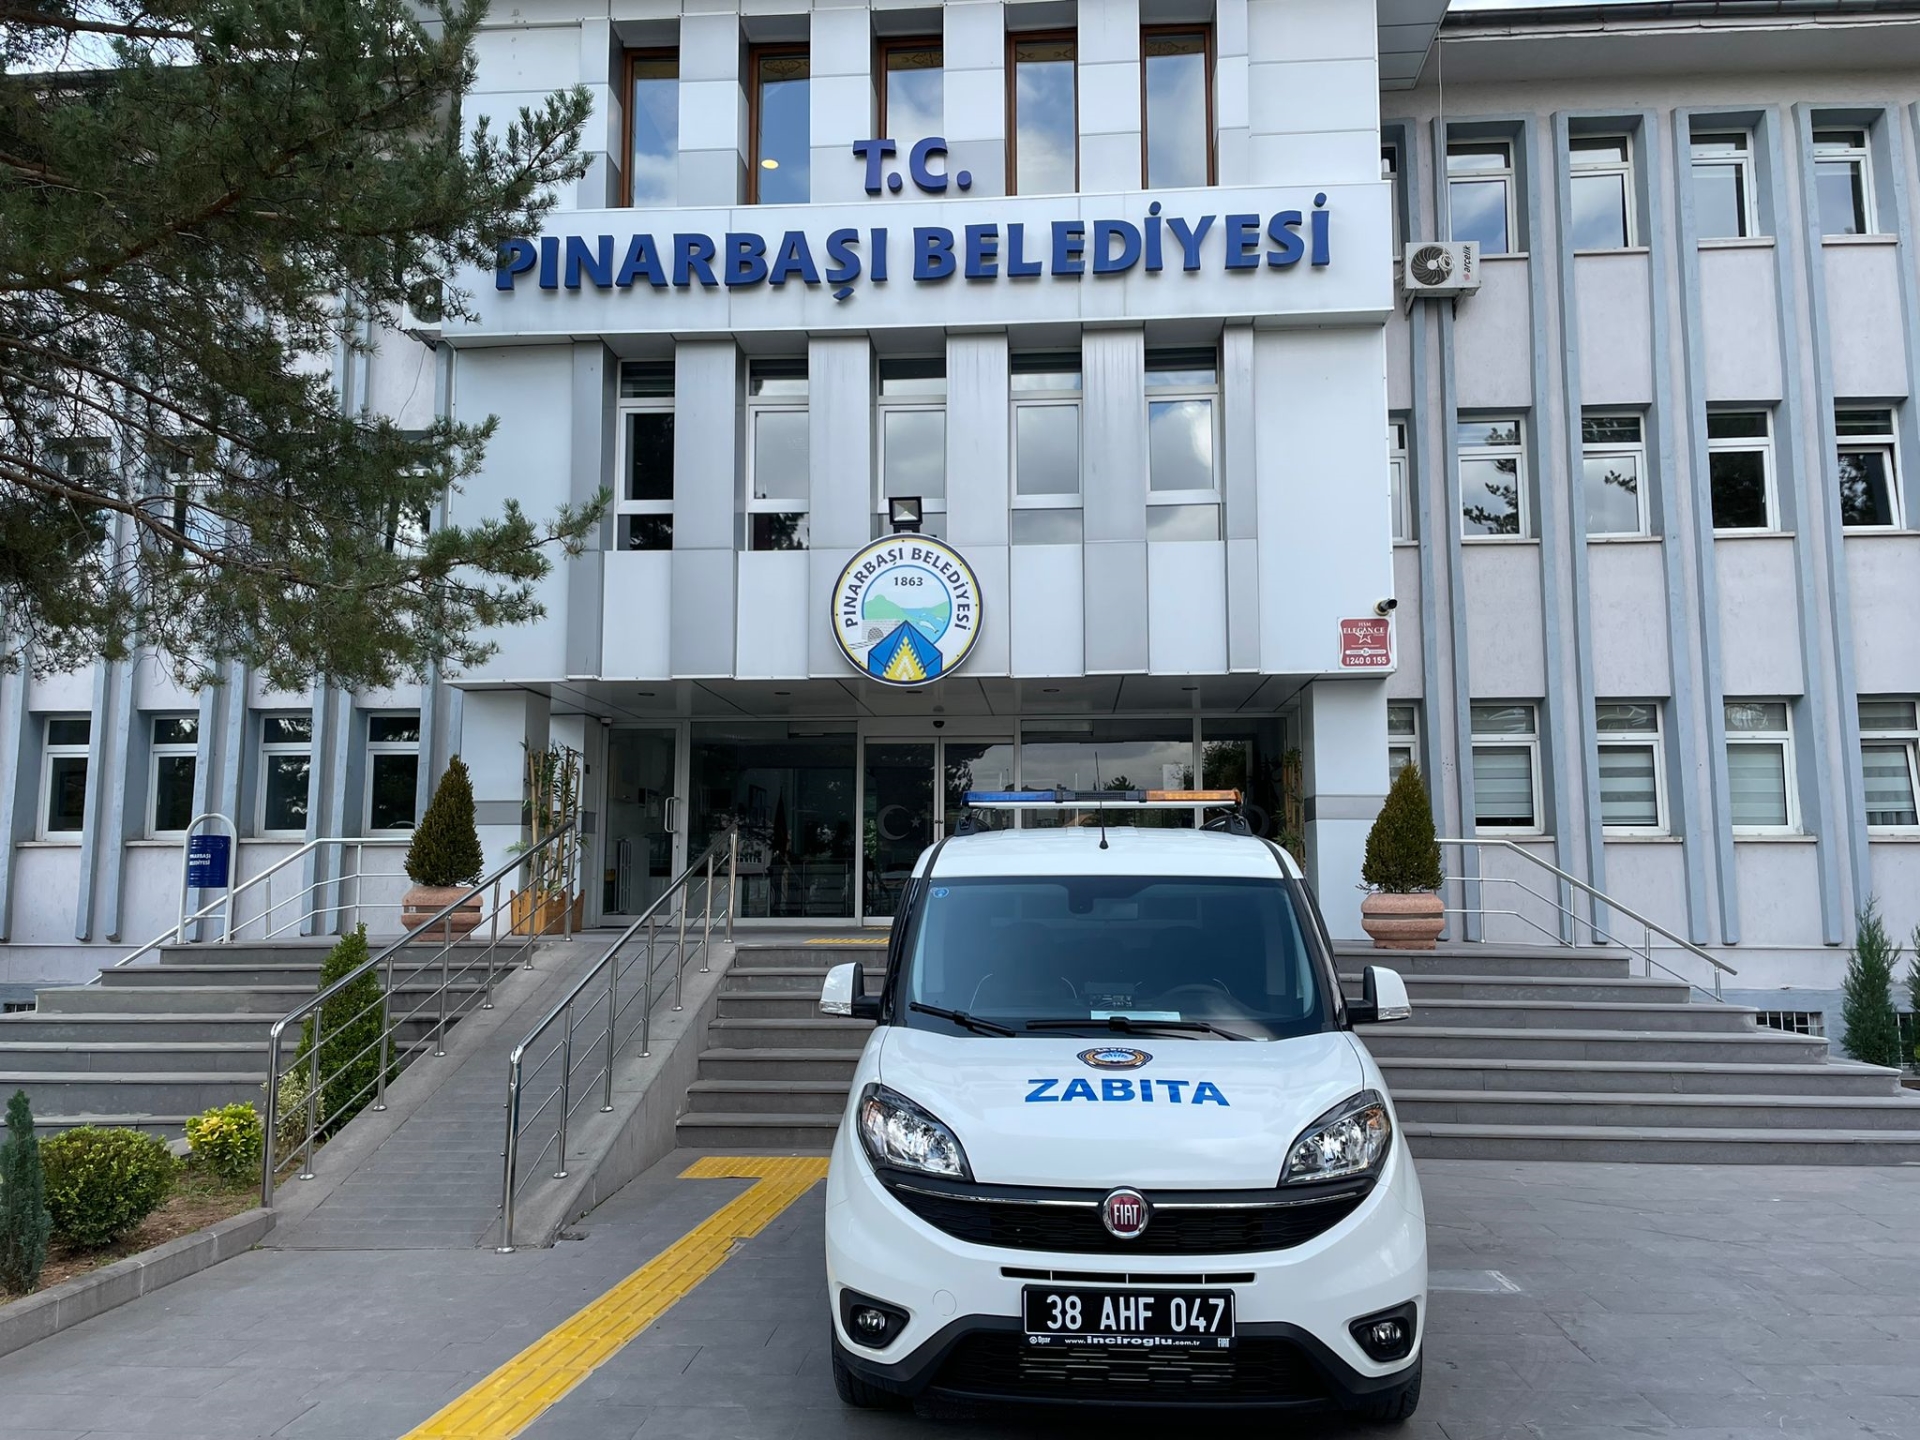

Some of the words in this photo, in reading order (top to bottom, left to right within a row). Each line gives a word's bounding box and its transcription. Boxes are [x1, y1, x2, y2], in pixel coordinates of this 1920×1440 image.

[853, 137, 972, 196] T.C.
[496, 228, 888, 302] PINARBAŞI
[913, 192, 1331, 281] BELEDİYESİ
[843, 547, 904, 629] PINARBAŞI
[910, 547, 971, 631] BELEDİYESİ
[893, 576, 924, 587] 1863
[1024, 1078, 1231, 1107] ZABITA
[1113, 1203, 1140, 1226] FIAT
[1046, 1294, 1083, 1330] 38
[1100, 1296, 1155, 1331] AHF
[1170, 1297, 1226, 1333] 047
[1064, 1335, 1201, 1347] www.inciroglu.com.tr
